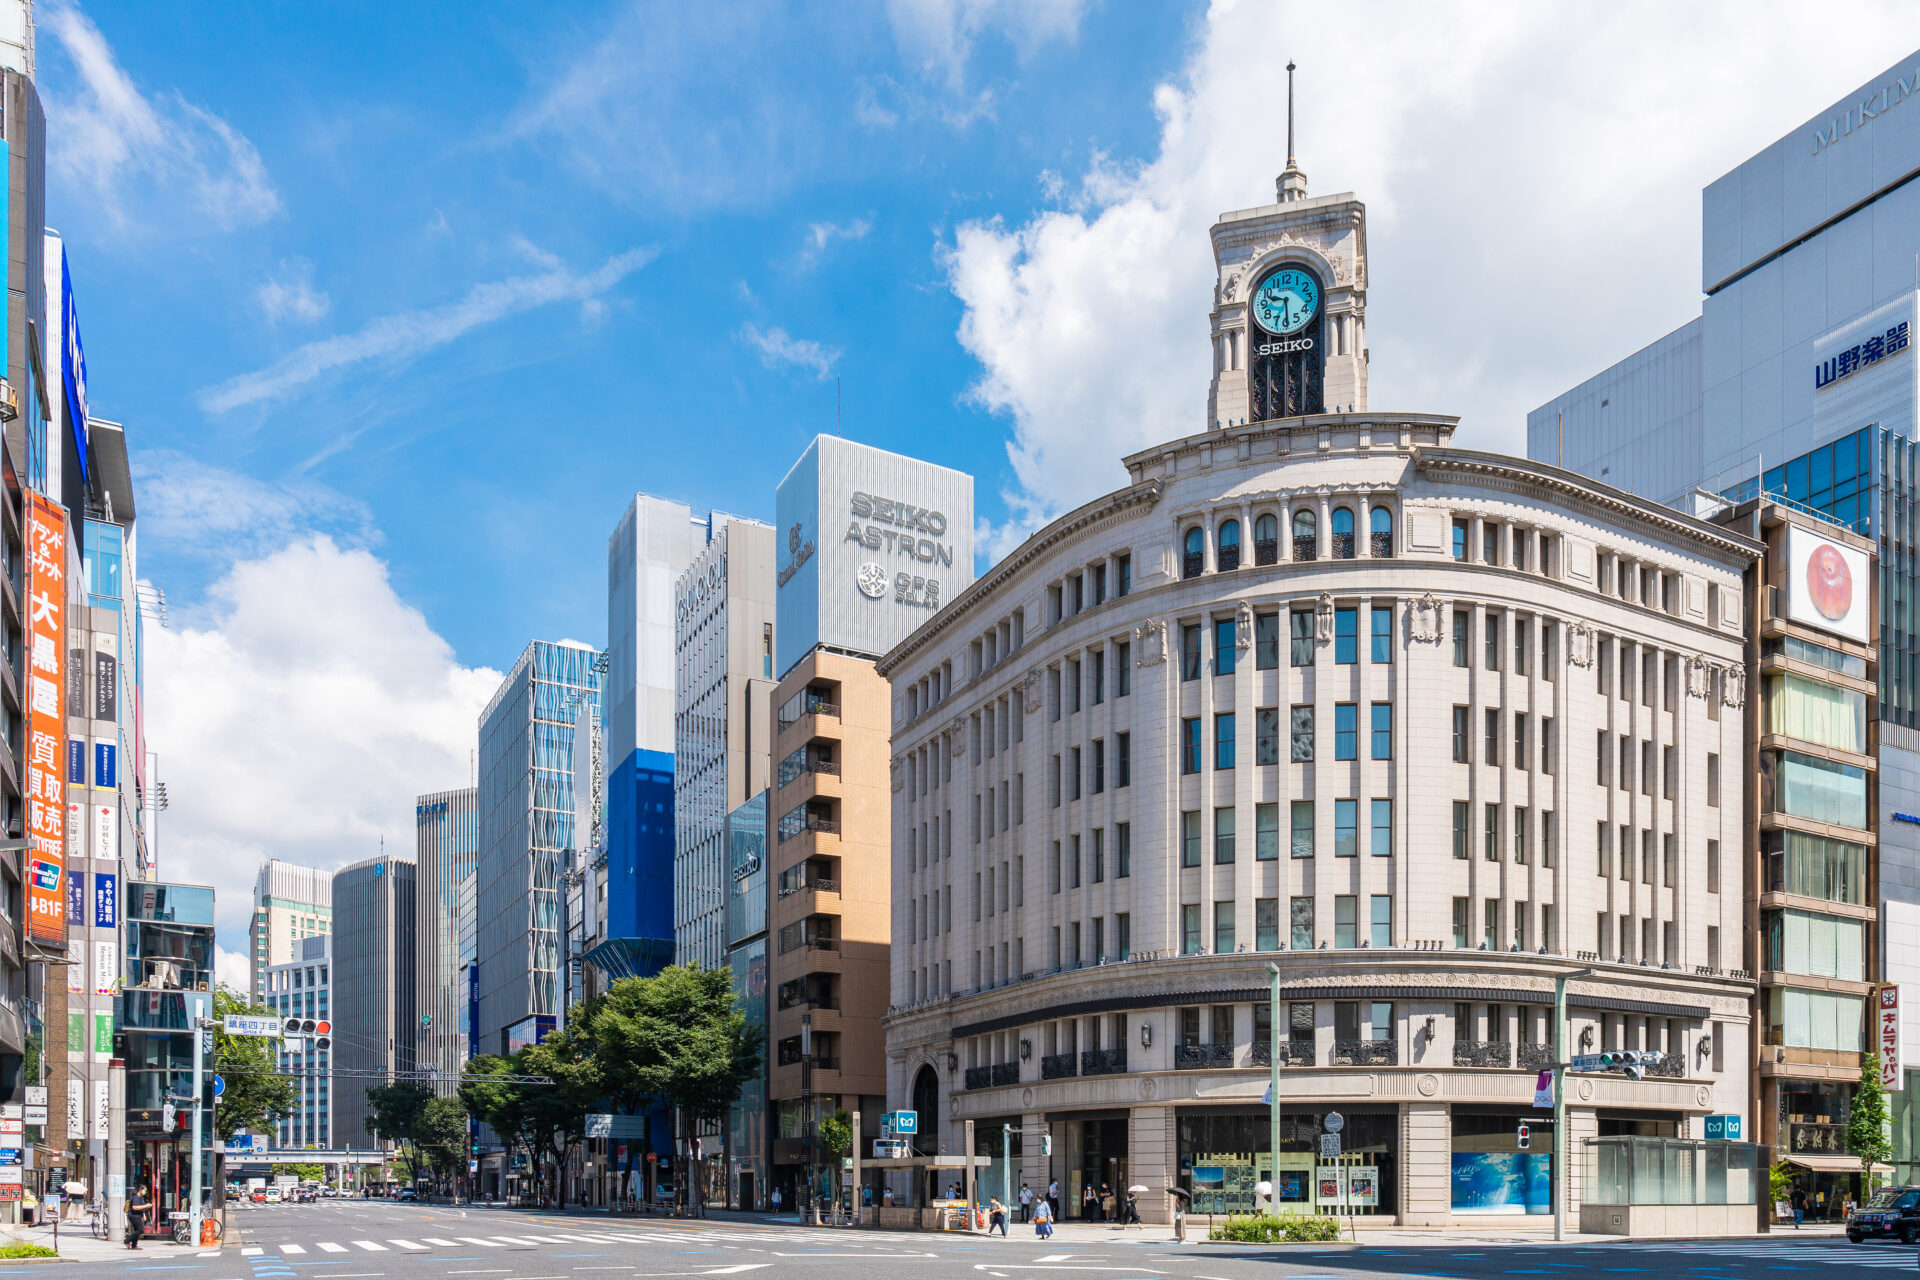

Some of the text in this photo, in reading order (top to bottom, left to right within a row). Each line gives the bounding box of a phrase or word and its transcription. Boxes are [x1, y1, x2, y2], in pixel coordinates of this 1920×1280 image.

[1273, 279, 1280, 288] 11
[1282, 274, 1291, 284] 12
[1296, 276, 1299, 285] 1
[1302, 282, 1309, 292] 2
[1264, 288, 1272, 298] 10
[1305, 293, 1312, 303] 3
[1260, 300, 1268, 309] 9
[1301, 304, 1309, 314] 4
[1264, 309, 1271, 319] 8
[1273, 316, 1280, 326] 7
[1293, 313, 1300, 323] 5
[1260, 338, 1313, 356] SEIKO
[1816, 321, 1911, 390] 山野楽器
[852, 491, 947, 536] SEIKO
[843, 522, 952, 568] ASTRON
[896, 572, 940, 595] GPS
[896, 588, 940, 610] SOLAR
[32, 591, 59, 719] 大黒屋
[32, 730, 58, 771] 質
[32, 768, 62, 804] 買取
[32, 800, 62, 836] 販売
[734, 857, 760, 882] SEIKO
[39, 897, 62, 916] B1F
[229, 1020, 277, 1030] 銀座四丁目
[1883, 1013, 1897, 1085] キムラヤのパン
